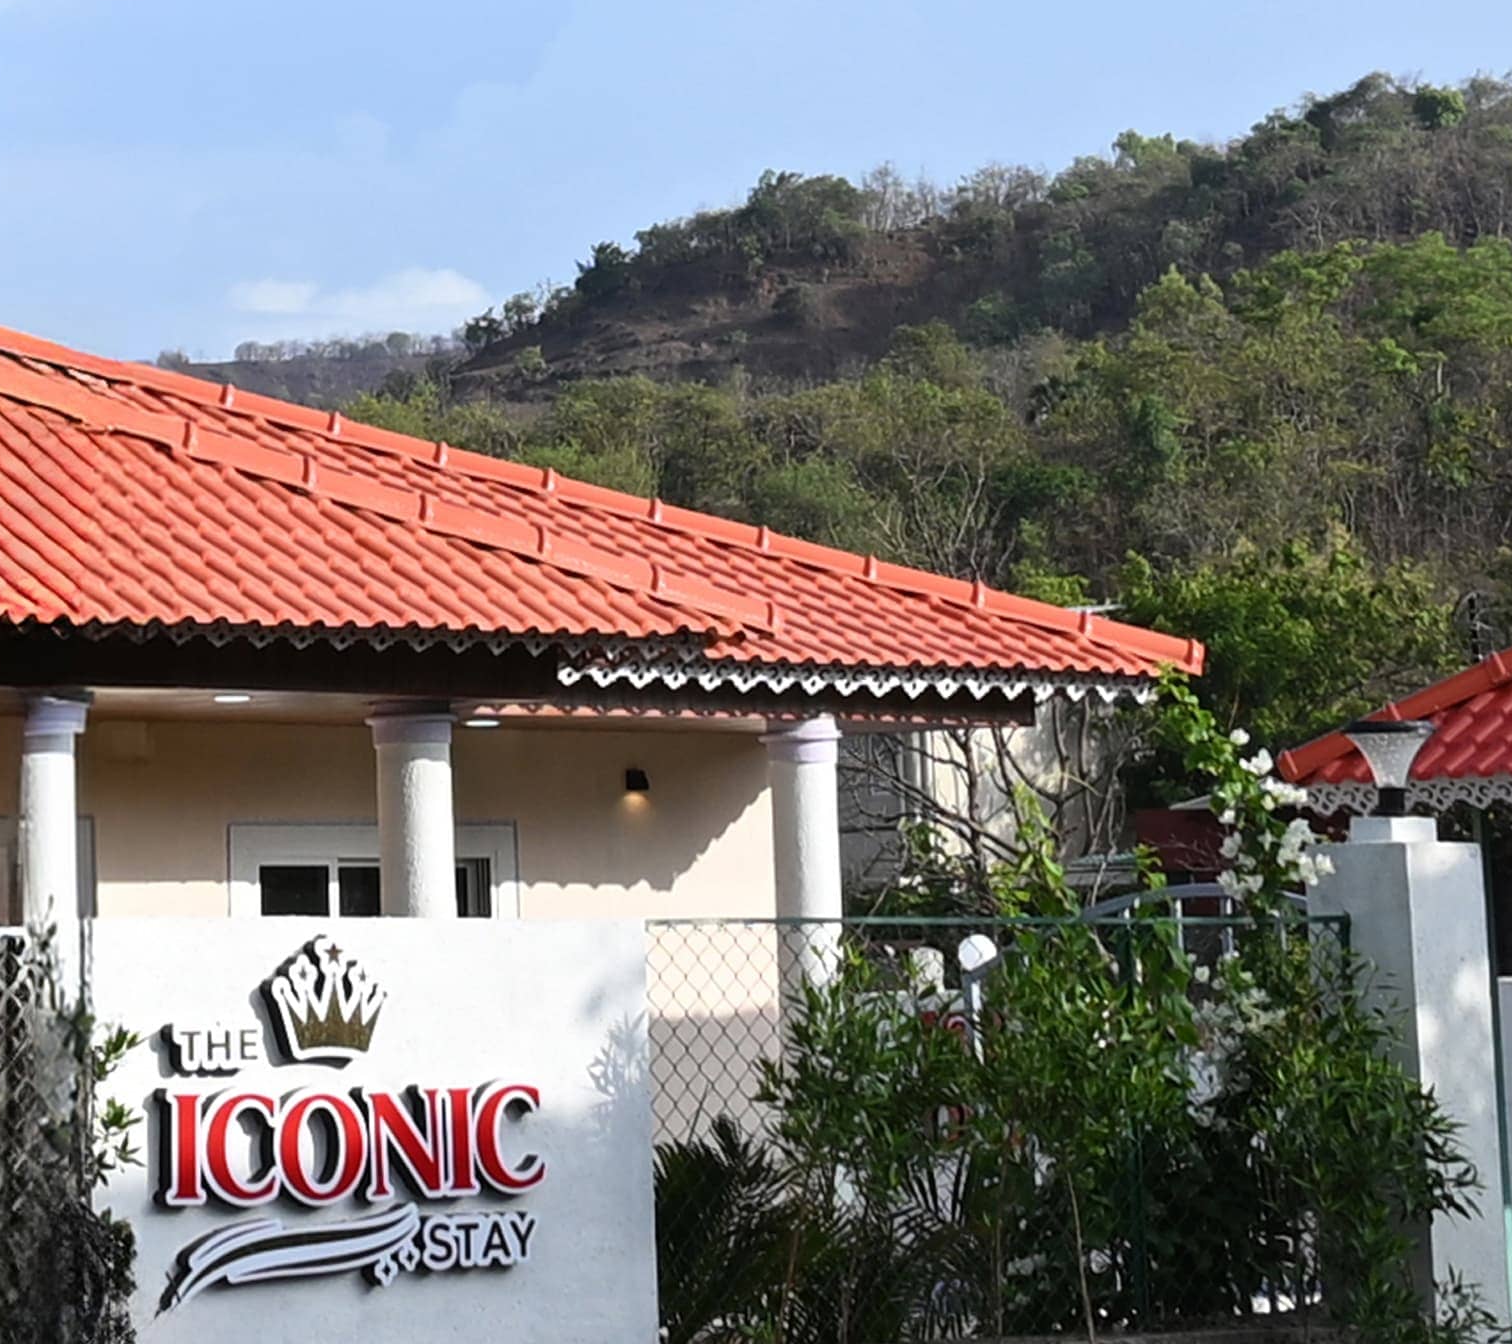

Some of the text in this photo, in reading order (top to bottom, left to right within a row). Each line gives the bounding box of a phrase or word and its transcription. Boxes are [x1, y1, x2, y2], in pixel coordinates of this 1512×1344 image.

[179, 1030, 258, 1061] THE
[172, 1085, 546, 1202] ICONIC
[427, 1220, 536, 1263] STAY
